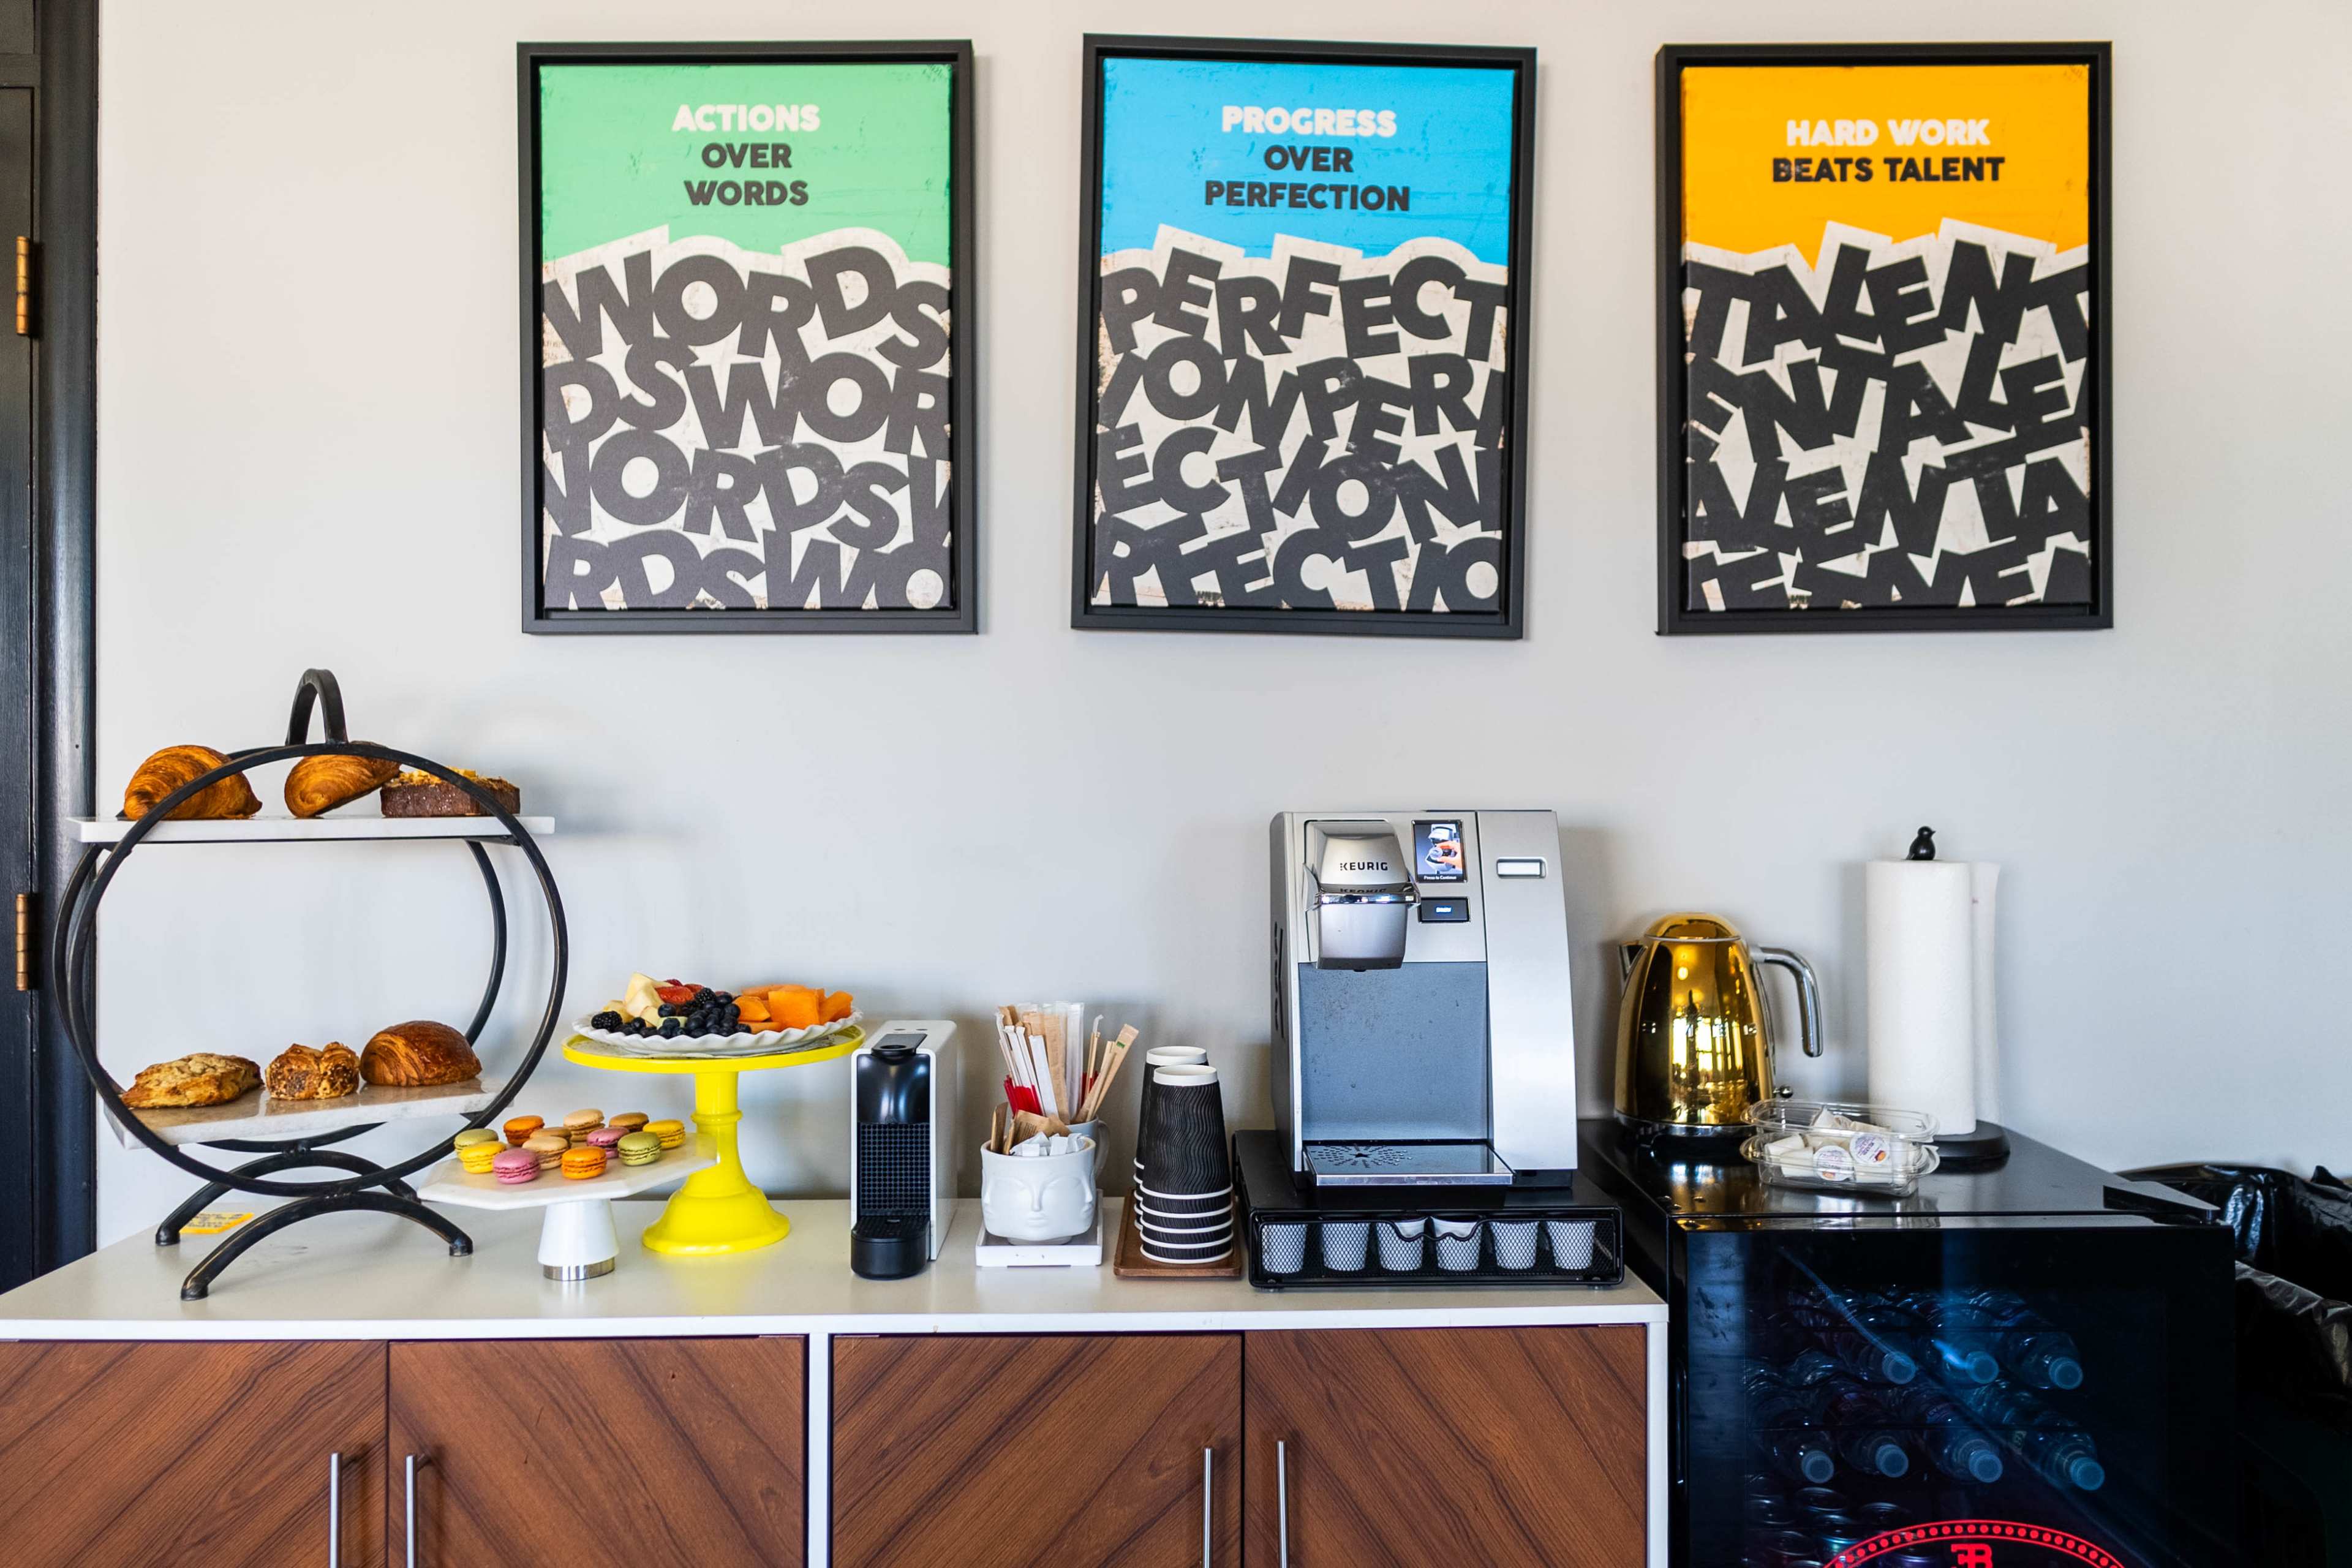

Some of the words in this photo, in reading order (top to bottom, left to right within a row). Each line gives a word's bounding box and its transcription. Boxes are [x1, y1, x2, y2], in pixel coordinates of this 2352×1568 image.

[671, 104, 821, 132] ACTIONS
[1222, 106, 1397, 137] PROGRESS
[1787, 119, 1878, 146] HARD
[1887, 119, 1991, 146] WORK
[701, 143, 793, 168] OVER
[1264, 145, 1354, 173] OVER
[1773, 157, 1874, 183] BEATS
[1883, 156, 2005, 182] TALENT
[684, 180, 809, 206] WORDS
[1205, 181, 1410, 212] PERFECTION
[543, 247, 951, 369] WORDS
[1100, 247, 1509, 363] PERFECT
[1686, 238, 2089, 368] TALENT
[1340, 862, 1389, 871] KEURIG
